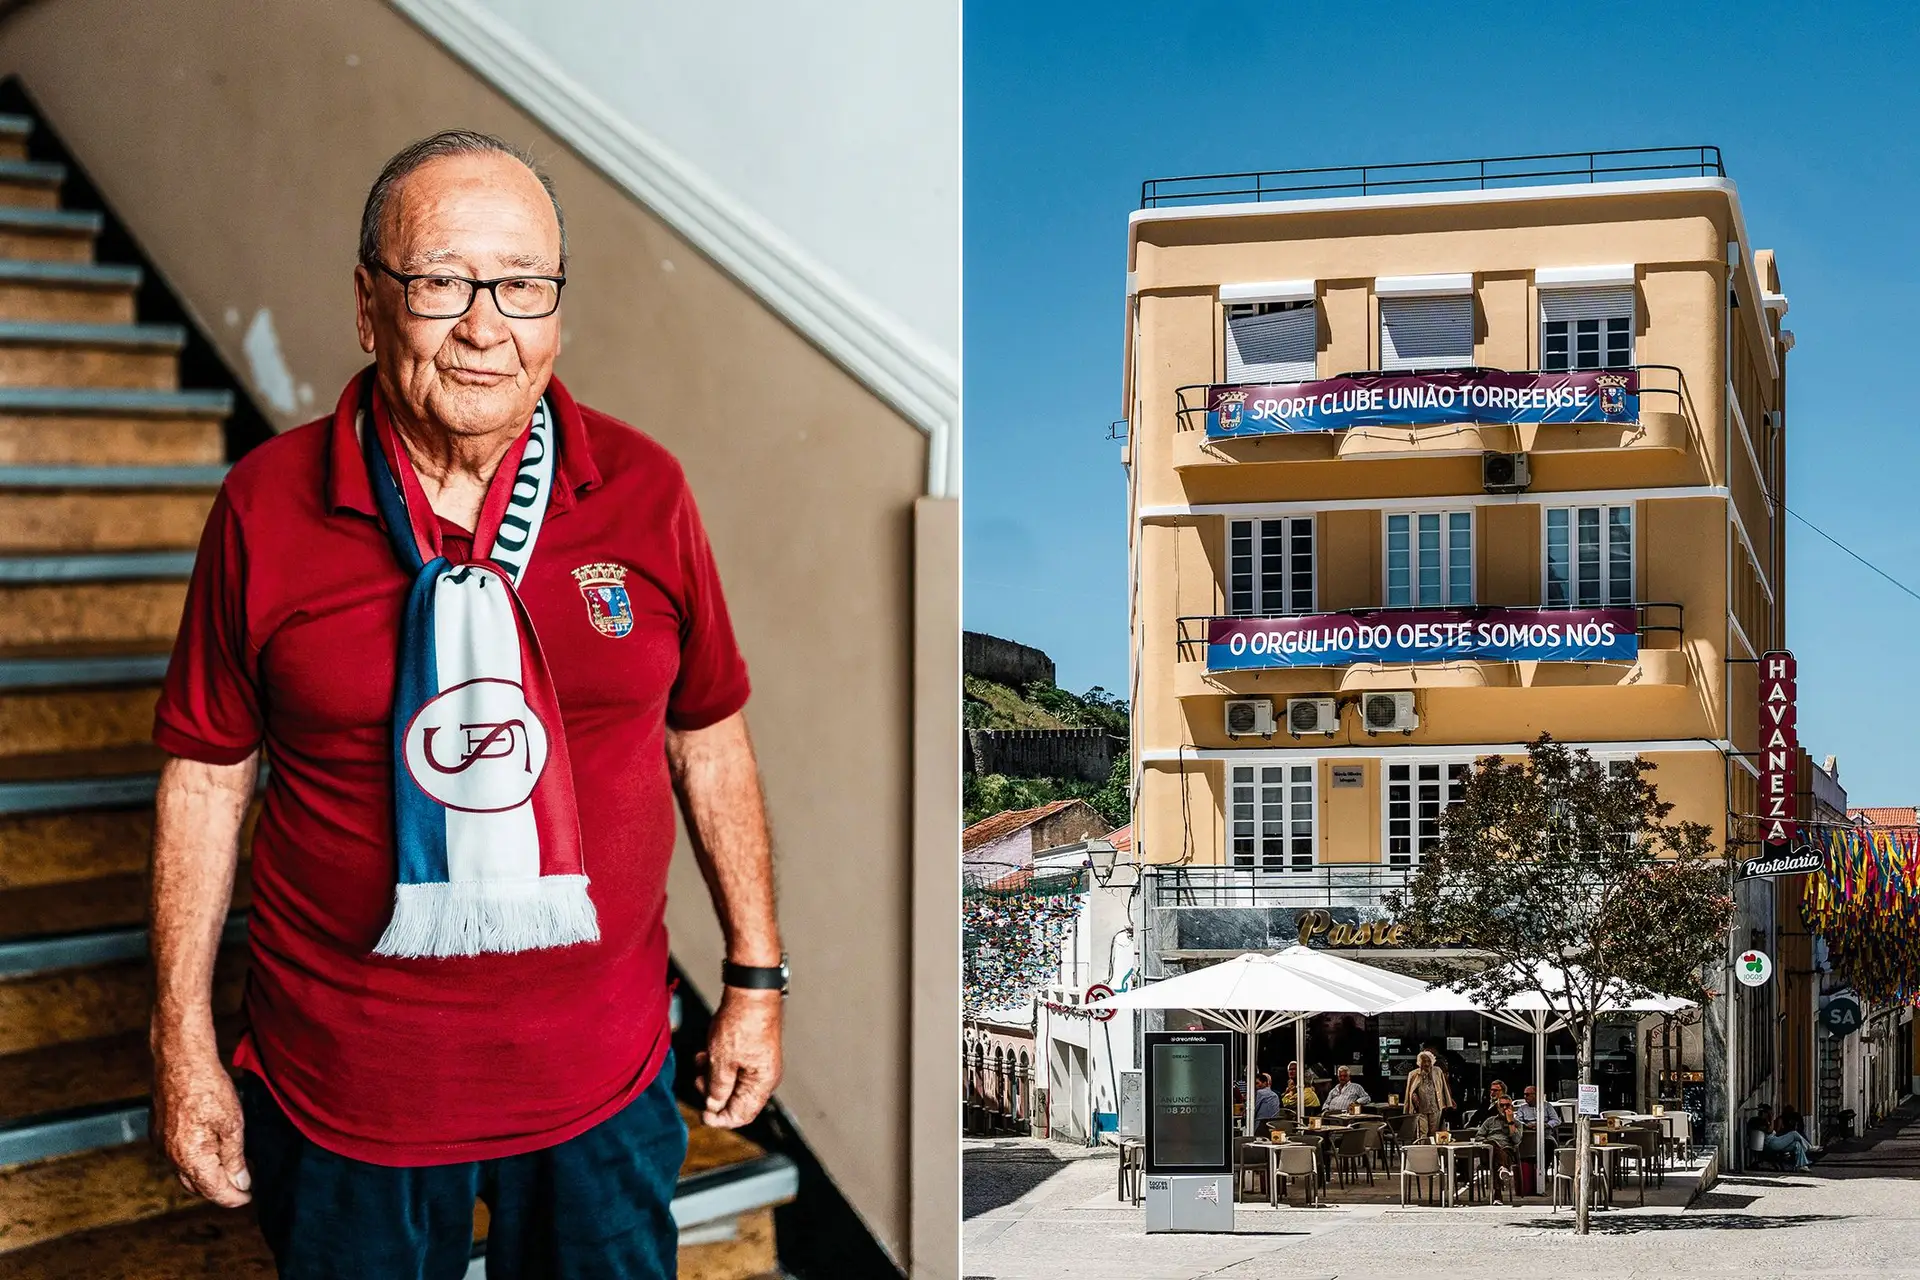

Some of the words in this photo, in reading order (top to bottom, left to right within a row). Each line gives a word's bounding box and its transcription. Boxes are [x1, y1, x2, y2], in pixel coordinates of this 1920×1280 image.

[1251, 395, 1318, 420] SPORT
[1320, 389, 1384, 414] CLUBE
[1388, 383, 1455, 409] UNIÃO
[1458, 385, 1588, 409] TORREENSE
[599, 622, 630, 633] SCUT
[1229, 632, 1247, 656] O
[1250, 626, 1354, 655] ORGULHO
[1358, 624, 1392, 649] DO
[1396, 622, 1473, 648] OESTE
[1477, 622, 1561, 648] SOMOS
[1566, 617, 1616, 647] NÓS
[1767, 658, 1788, 841] HAVANEZA
[1746, 853, 1820, 876] Pastelaria
[1830, 1009, 1855, 1025] SA
